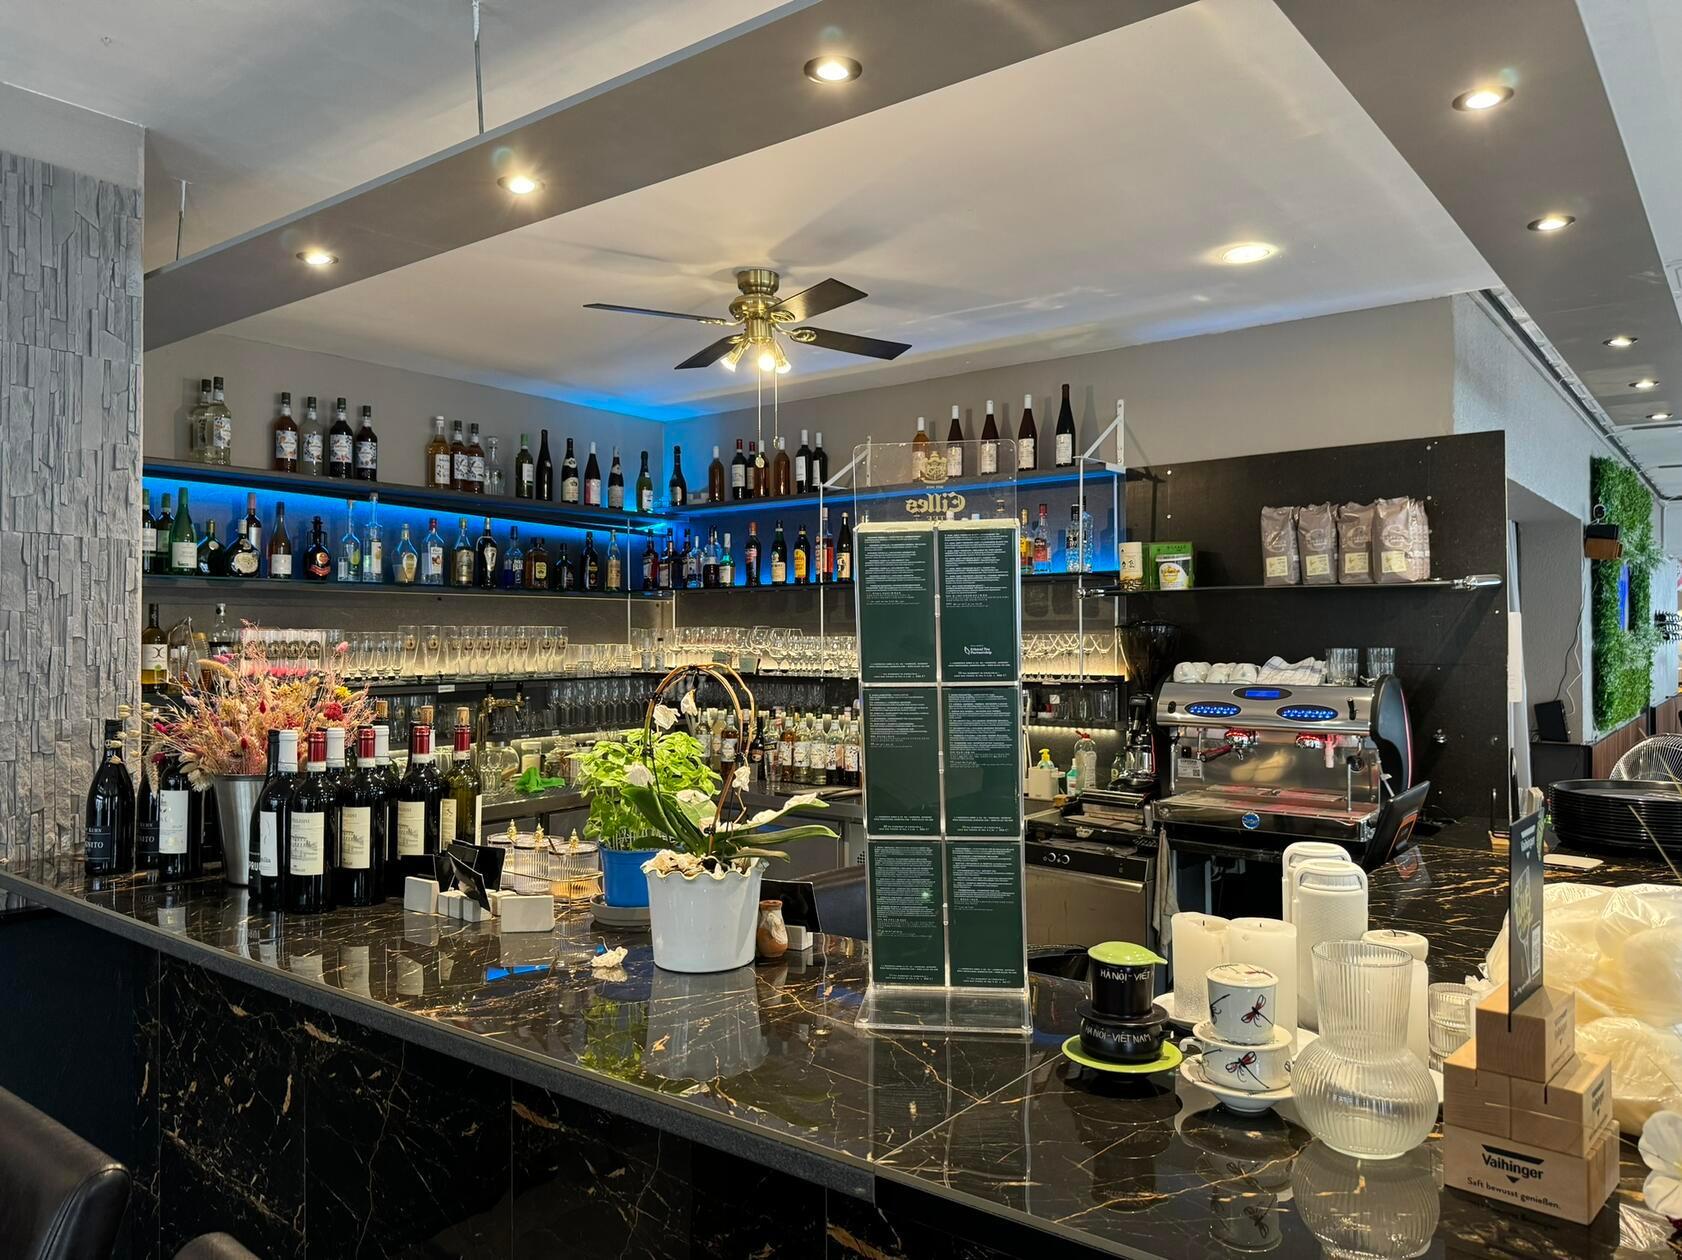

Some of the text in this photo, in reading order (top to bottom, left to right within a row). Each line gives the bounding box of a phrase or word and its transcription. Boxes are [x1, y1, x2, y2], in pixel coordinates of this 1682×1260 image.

[1132, 1033, 1152, 1044] NAM
[1482, 1153, 1544, 1180] Vaihinger
[1466, 1176, 1561, 1209] Saft bewusst genießen.
